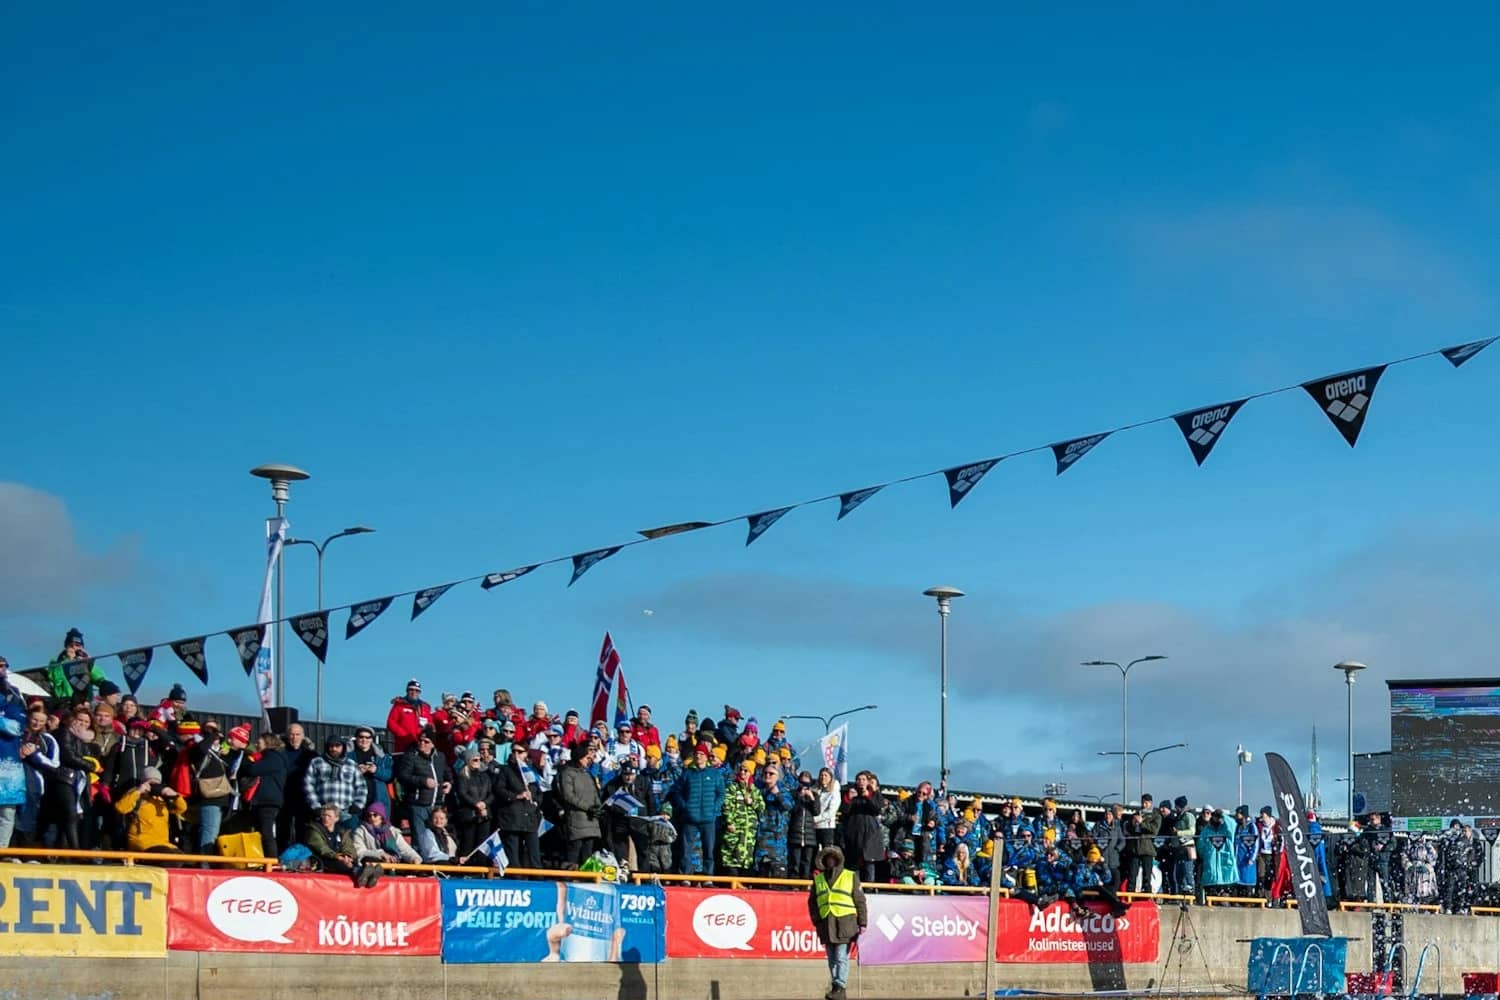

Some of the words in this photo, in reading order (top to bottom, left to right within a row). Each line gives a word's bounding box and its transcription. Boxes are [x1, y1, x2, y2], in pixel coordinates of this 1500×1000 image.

[1325, 375, 1367, 400] arena
[1191, 406, 1232, 429] arena
[1283, 793, 1318, 898] dryrobe
[0, 877, 153, 936] ENT
[221, 898, 283, 915] TERE
[455, 888, 532, 908] VYTAUTAS
[456, 910, 502, 929] PEALE
[566, 901, 614, 924] Vytautas
[703, 913, 746, 928] TERE
[318, 914, 409, 948] KÕIGILE
[771, 926, 826, 953] KÕIGIL
[911, 914, 980, 942] Stebby
[1028, 937, 1114, 952] Kolimisteenused
